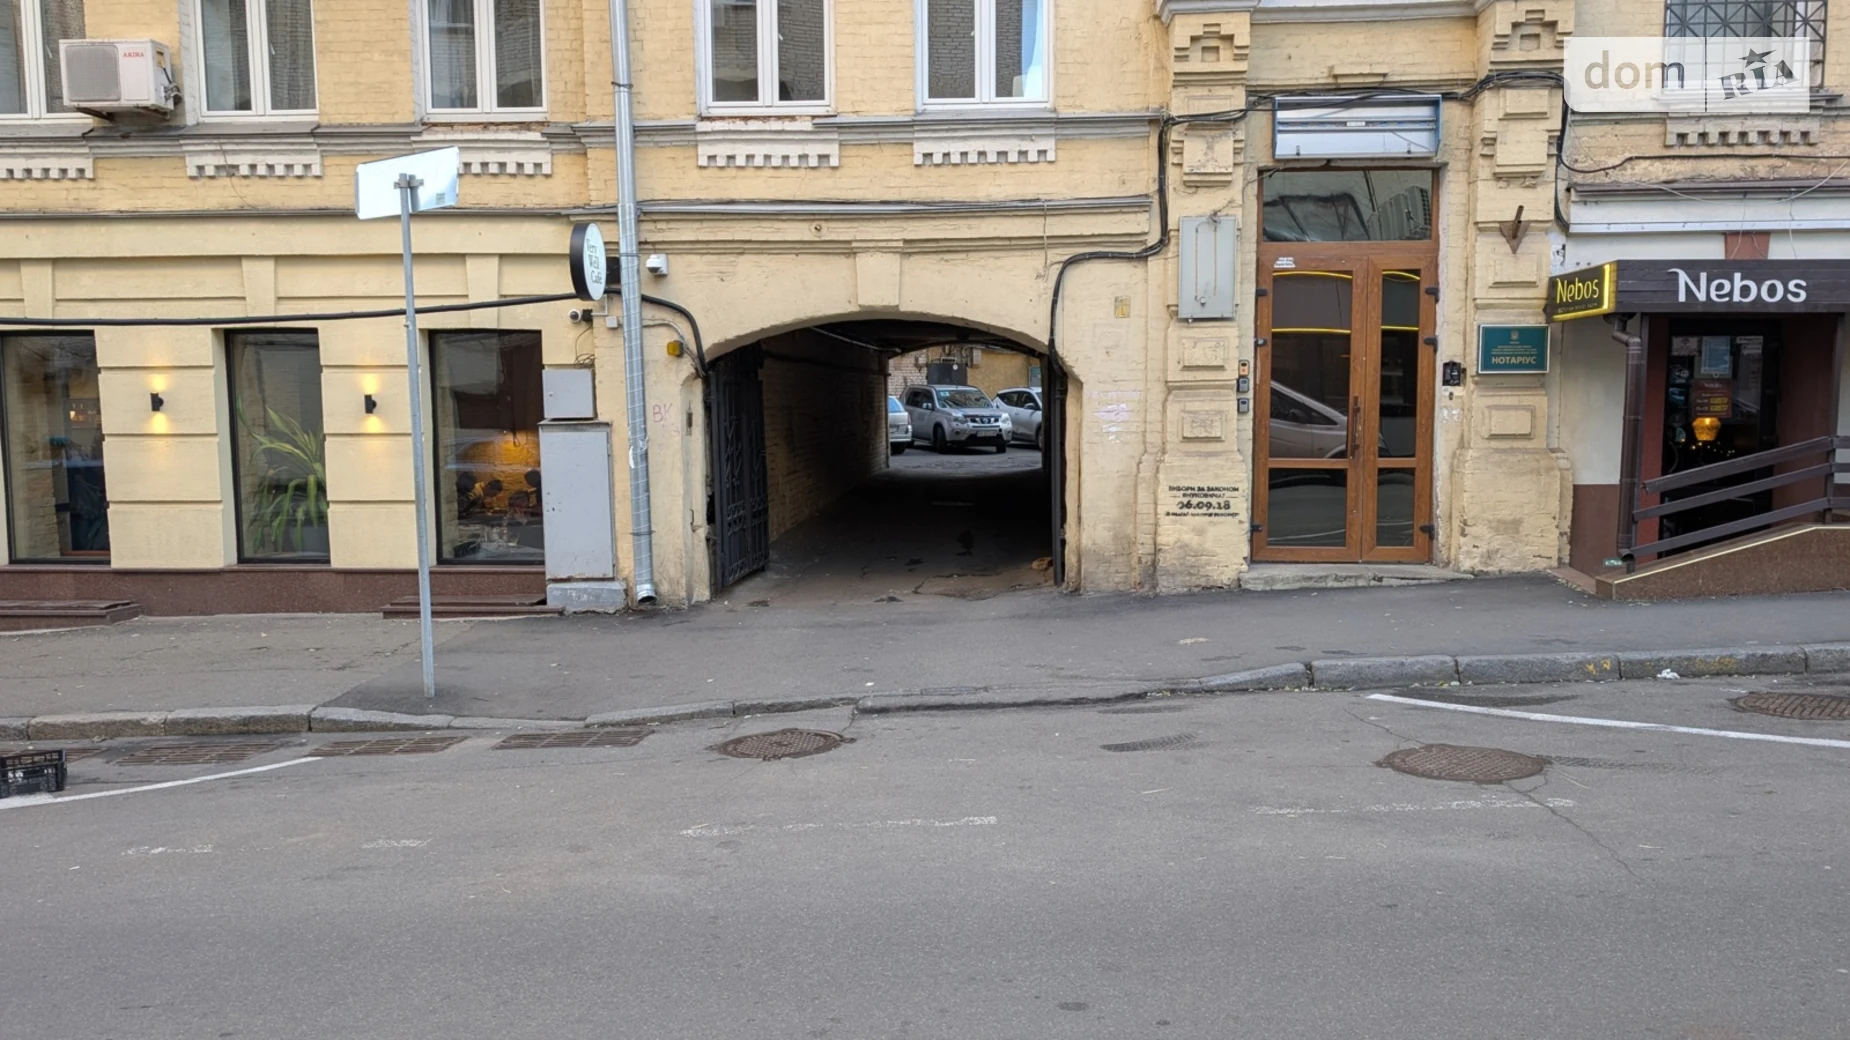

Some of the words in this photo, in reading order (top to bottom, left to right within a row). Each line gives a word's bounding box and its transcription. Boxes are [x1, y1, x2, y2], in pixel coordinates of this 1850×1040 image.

[1556, 276, 1600, 305] Nebos
[1666, 267, 1807, 303] Nebos
[1490, 355, 1538, 365] НОТАРІУС
